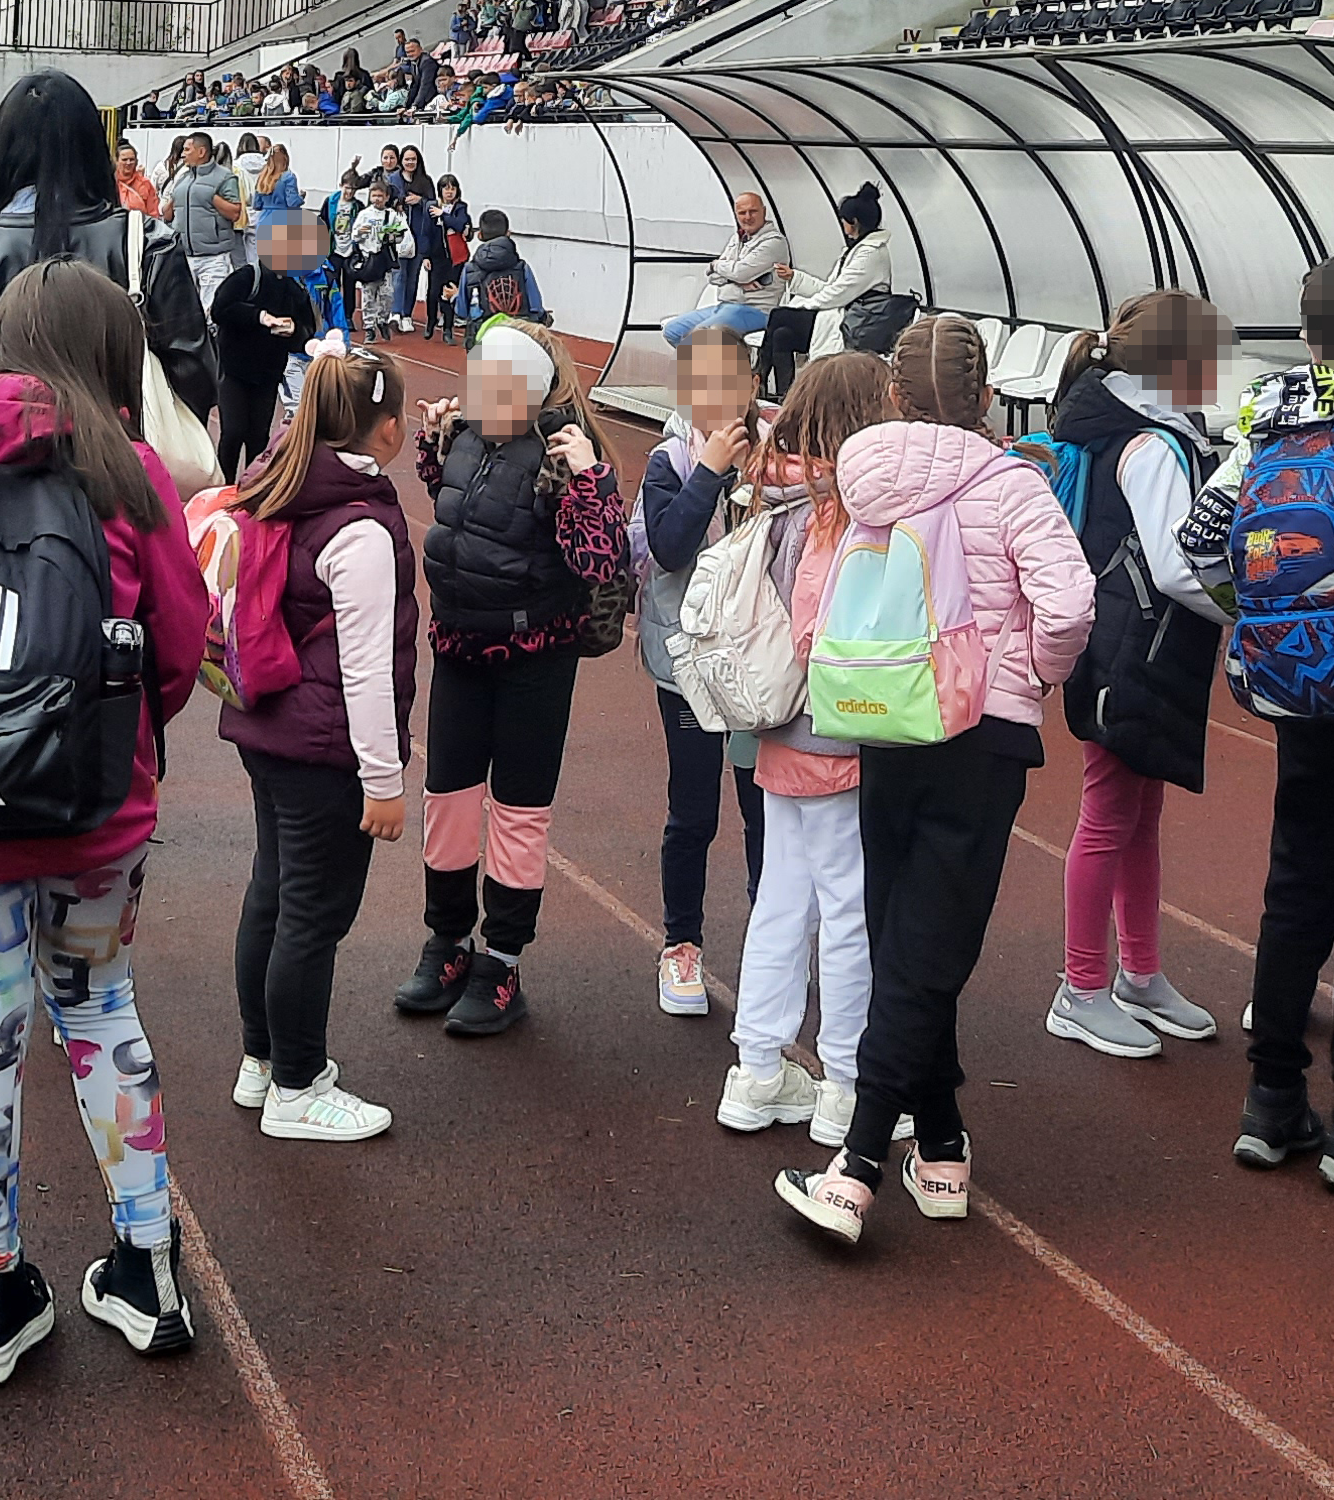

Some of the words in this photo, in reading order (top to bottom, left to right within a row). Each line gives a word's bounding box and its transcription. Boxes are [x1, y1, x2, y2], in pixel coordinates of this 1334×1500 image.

[903, 29, 921, 42] IV
[1193, 505, 1231, 535] YOUR
[836, 699, 888, 715] adidas
[920, 1178, 967, 1195] REPLA
[824, 1191, 864, 1219] REPL
